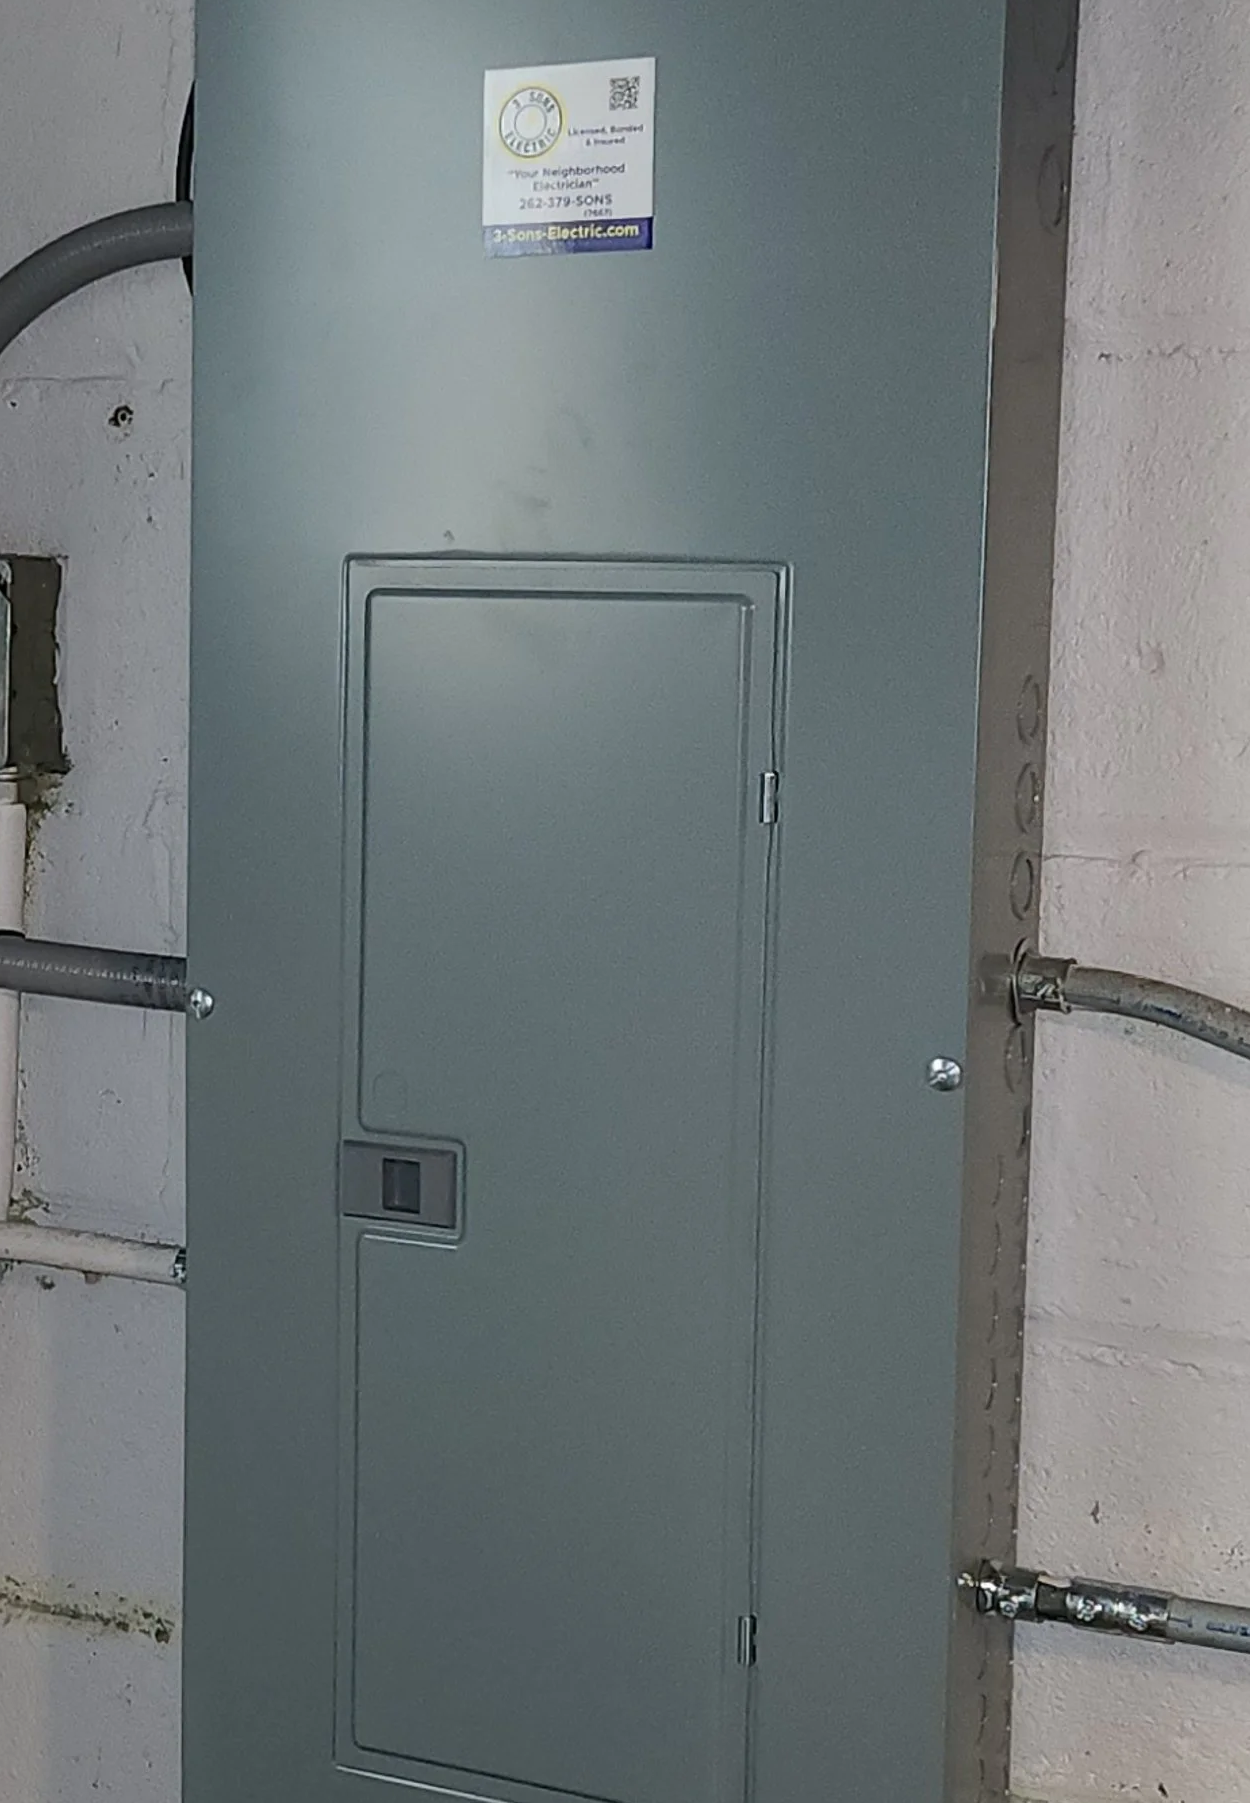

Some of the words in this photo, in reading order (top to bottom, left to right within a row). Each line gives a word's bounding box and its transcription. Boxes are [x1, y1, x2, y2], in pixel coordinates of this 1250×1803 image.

[528, 91, 555, 113] SONS
[504, 127, 556, 153] ELECTRIC
[541, 163, 625, 178] Neighborhood
[518, 193, 613, 209] 262-379-SONS
[492, 223, 639, 243] 3-Sons-Electric.com
